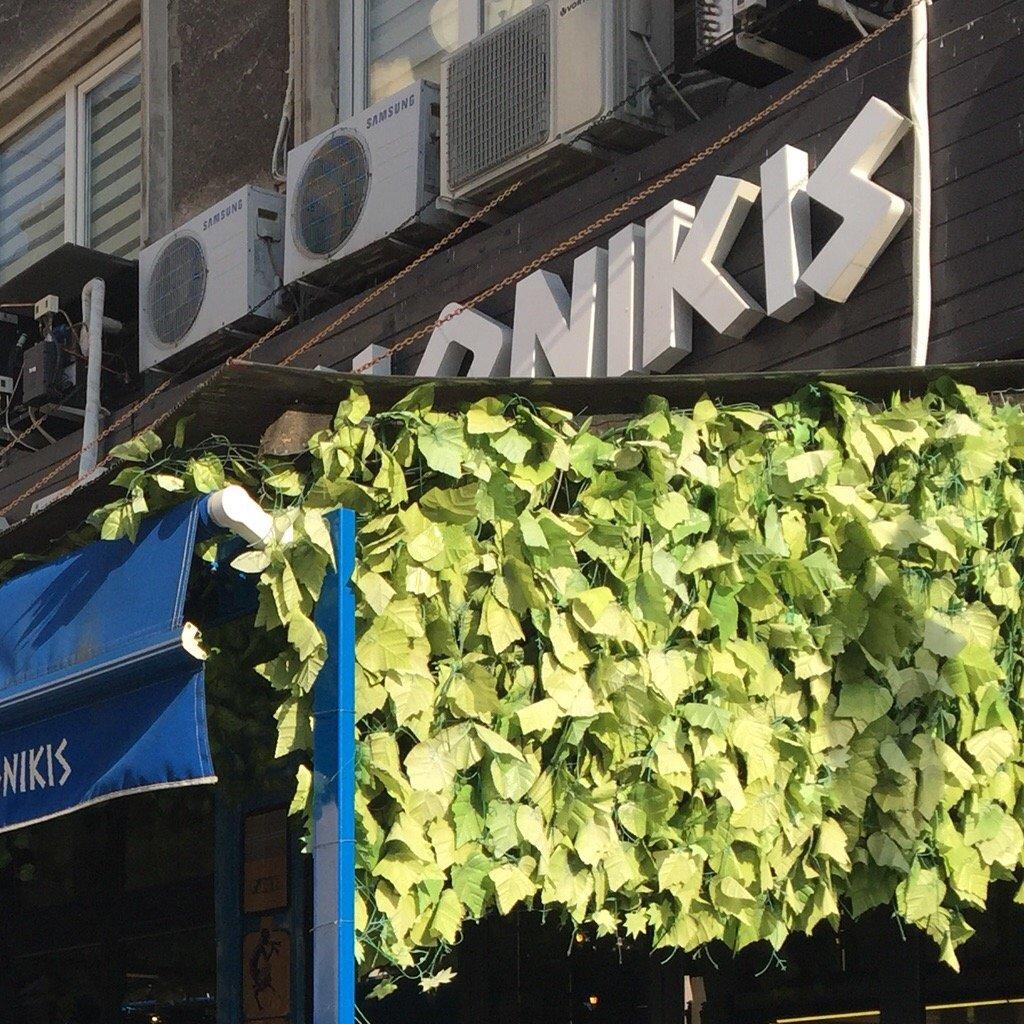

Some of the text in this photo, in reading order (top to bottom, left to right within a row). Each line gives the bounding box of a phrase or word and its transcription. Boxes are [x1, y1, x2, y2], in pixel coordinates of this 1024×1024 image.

[366, 94, 415, 130] SAMSUNG
[202, 199, 243, 231] SAMSUNG
[352, 96, 912, 378] ONIKIS
